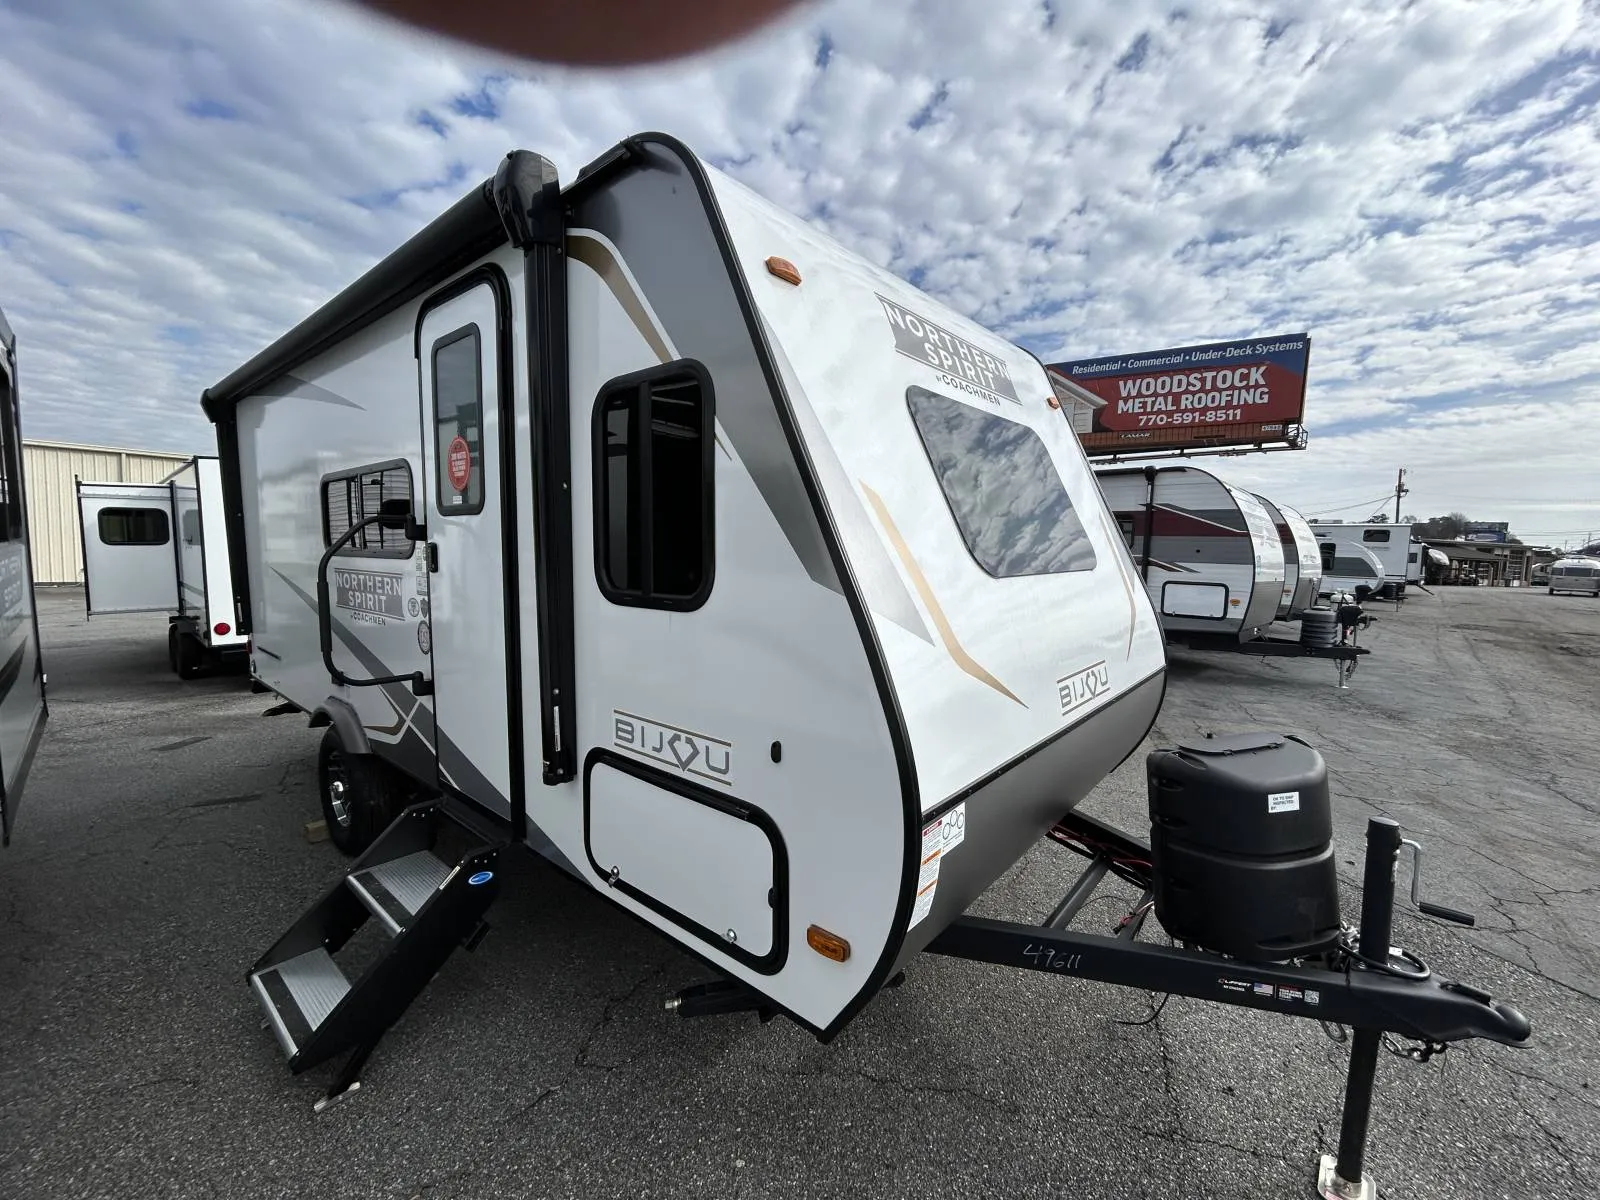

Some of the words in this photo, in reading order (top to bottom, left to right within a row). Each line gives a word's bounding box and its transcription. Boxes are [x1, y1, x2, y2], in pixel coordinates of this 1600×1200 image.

[883, 302, 1011, 379] NORTHERN
[924, 342, 996, 390] SPIRIT
[1072, 360, 1121, 375] Residential
[1127, 353, 1184, 369] Commercial
[1191, 346, 1253, 361] Under-Deck
[1254, 340, 1303, 355] Systems
[941, 374, 1001, 406] COACHMEN
[1118, 365, 1269, 398] WOODSTOCK
[1117, 395, 1177, 415] METAL
[1180, 387, 1269, 410] ROOFING
[1138, 408, 1241, 427] 770-591-8511
[335, 572, 402, 596] NORTHERN
[348, 590, 387, 613] SPIRIT
[354, 611, 386, 626] COACHMEN
[1059, 666, 1109, 709] BIJOU
[615, 717, 730, 775] BIJOU
[1023, 944, 1081, 969] 49611
